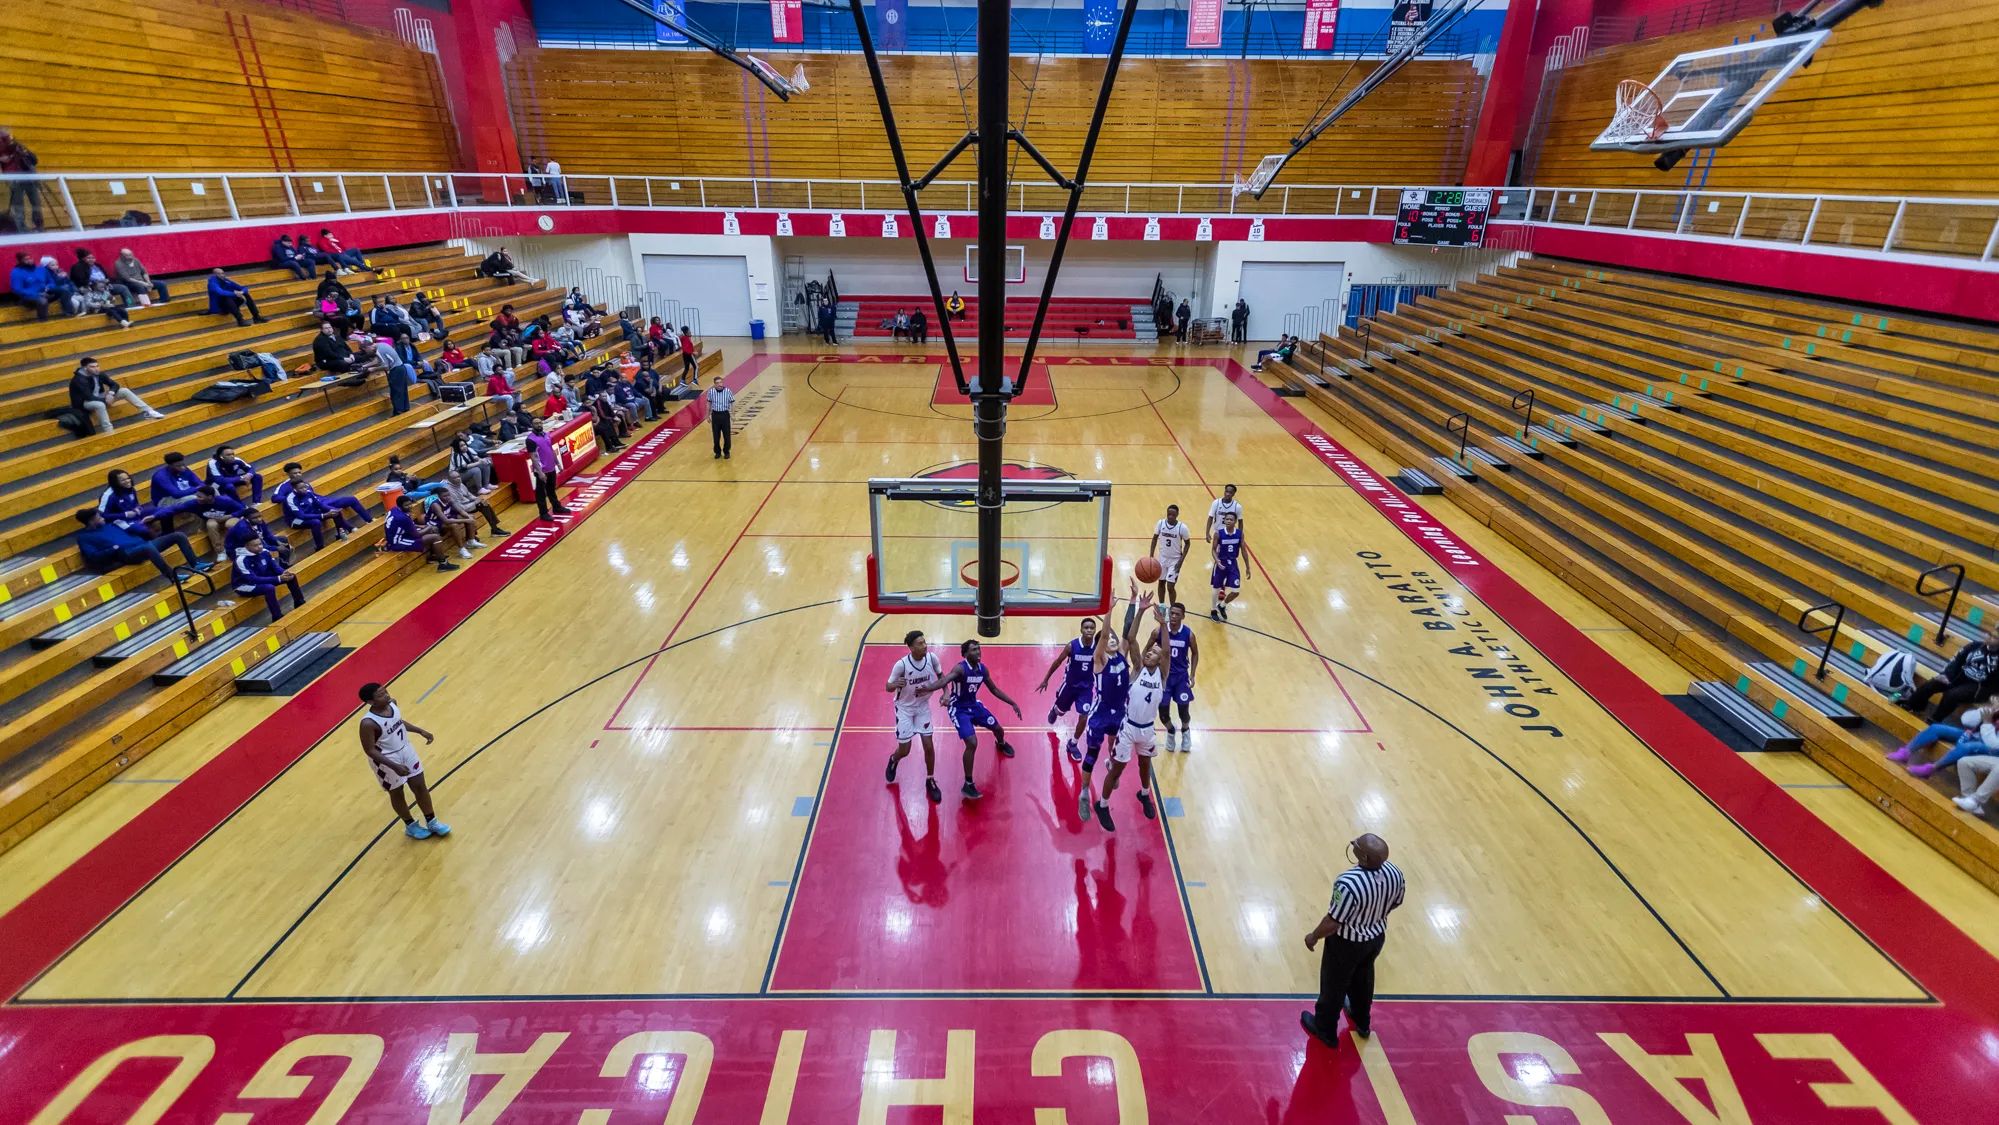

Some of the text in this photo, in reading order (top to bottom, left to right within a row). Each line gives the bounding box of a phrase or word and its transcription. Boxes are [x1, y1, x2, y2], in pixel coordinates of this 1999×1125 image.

[1407, 210, 1419, 223] 10
[1467, 211, 1485, 225] 21
[1400, 227, 1408, 238] 6
[1471, 230, 1479, 242] 6
[817, 355, 1175, 366] CARDNALS
[637, 428, 681, 450] Learning
[1303, 434, 1339, 451] TAKES!
[627, 451, 653, 460] For
[552, 514, 575, 524] IT
[1398, 511, 1428, 524] For
[499, 526, 560, 558] TAKES!
[1165, 539, 1172, 547] 3
[1227, 544, 1234, 553] 2
[1417, 526, 1480, 566] Learning
[1410, 571, 1559, 696] ATHLETIC CENTER
[1356, 550, 1564, 738] JOHN A. BARATTO
[1171, 647, 1179, 658] 0
[1081, 662, 1089, 671] 5
[909, 675, 931, 686] CARDINALS
[1116, 674, 1122, 687] 1
[1139, 679, 1161, 690] CARDINALS
[1144, 691, 1153, 704] 4
[396, 728, 404, 741] 7
